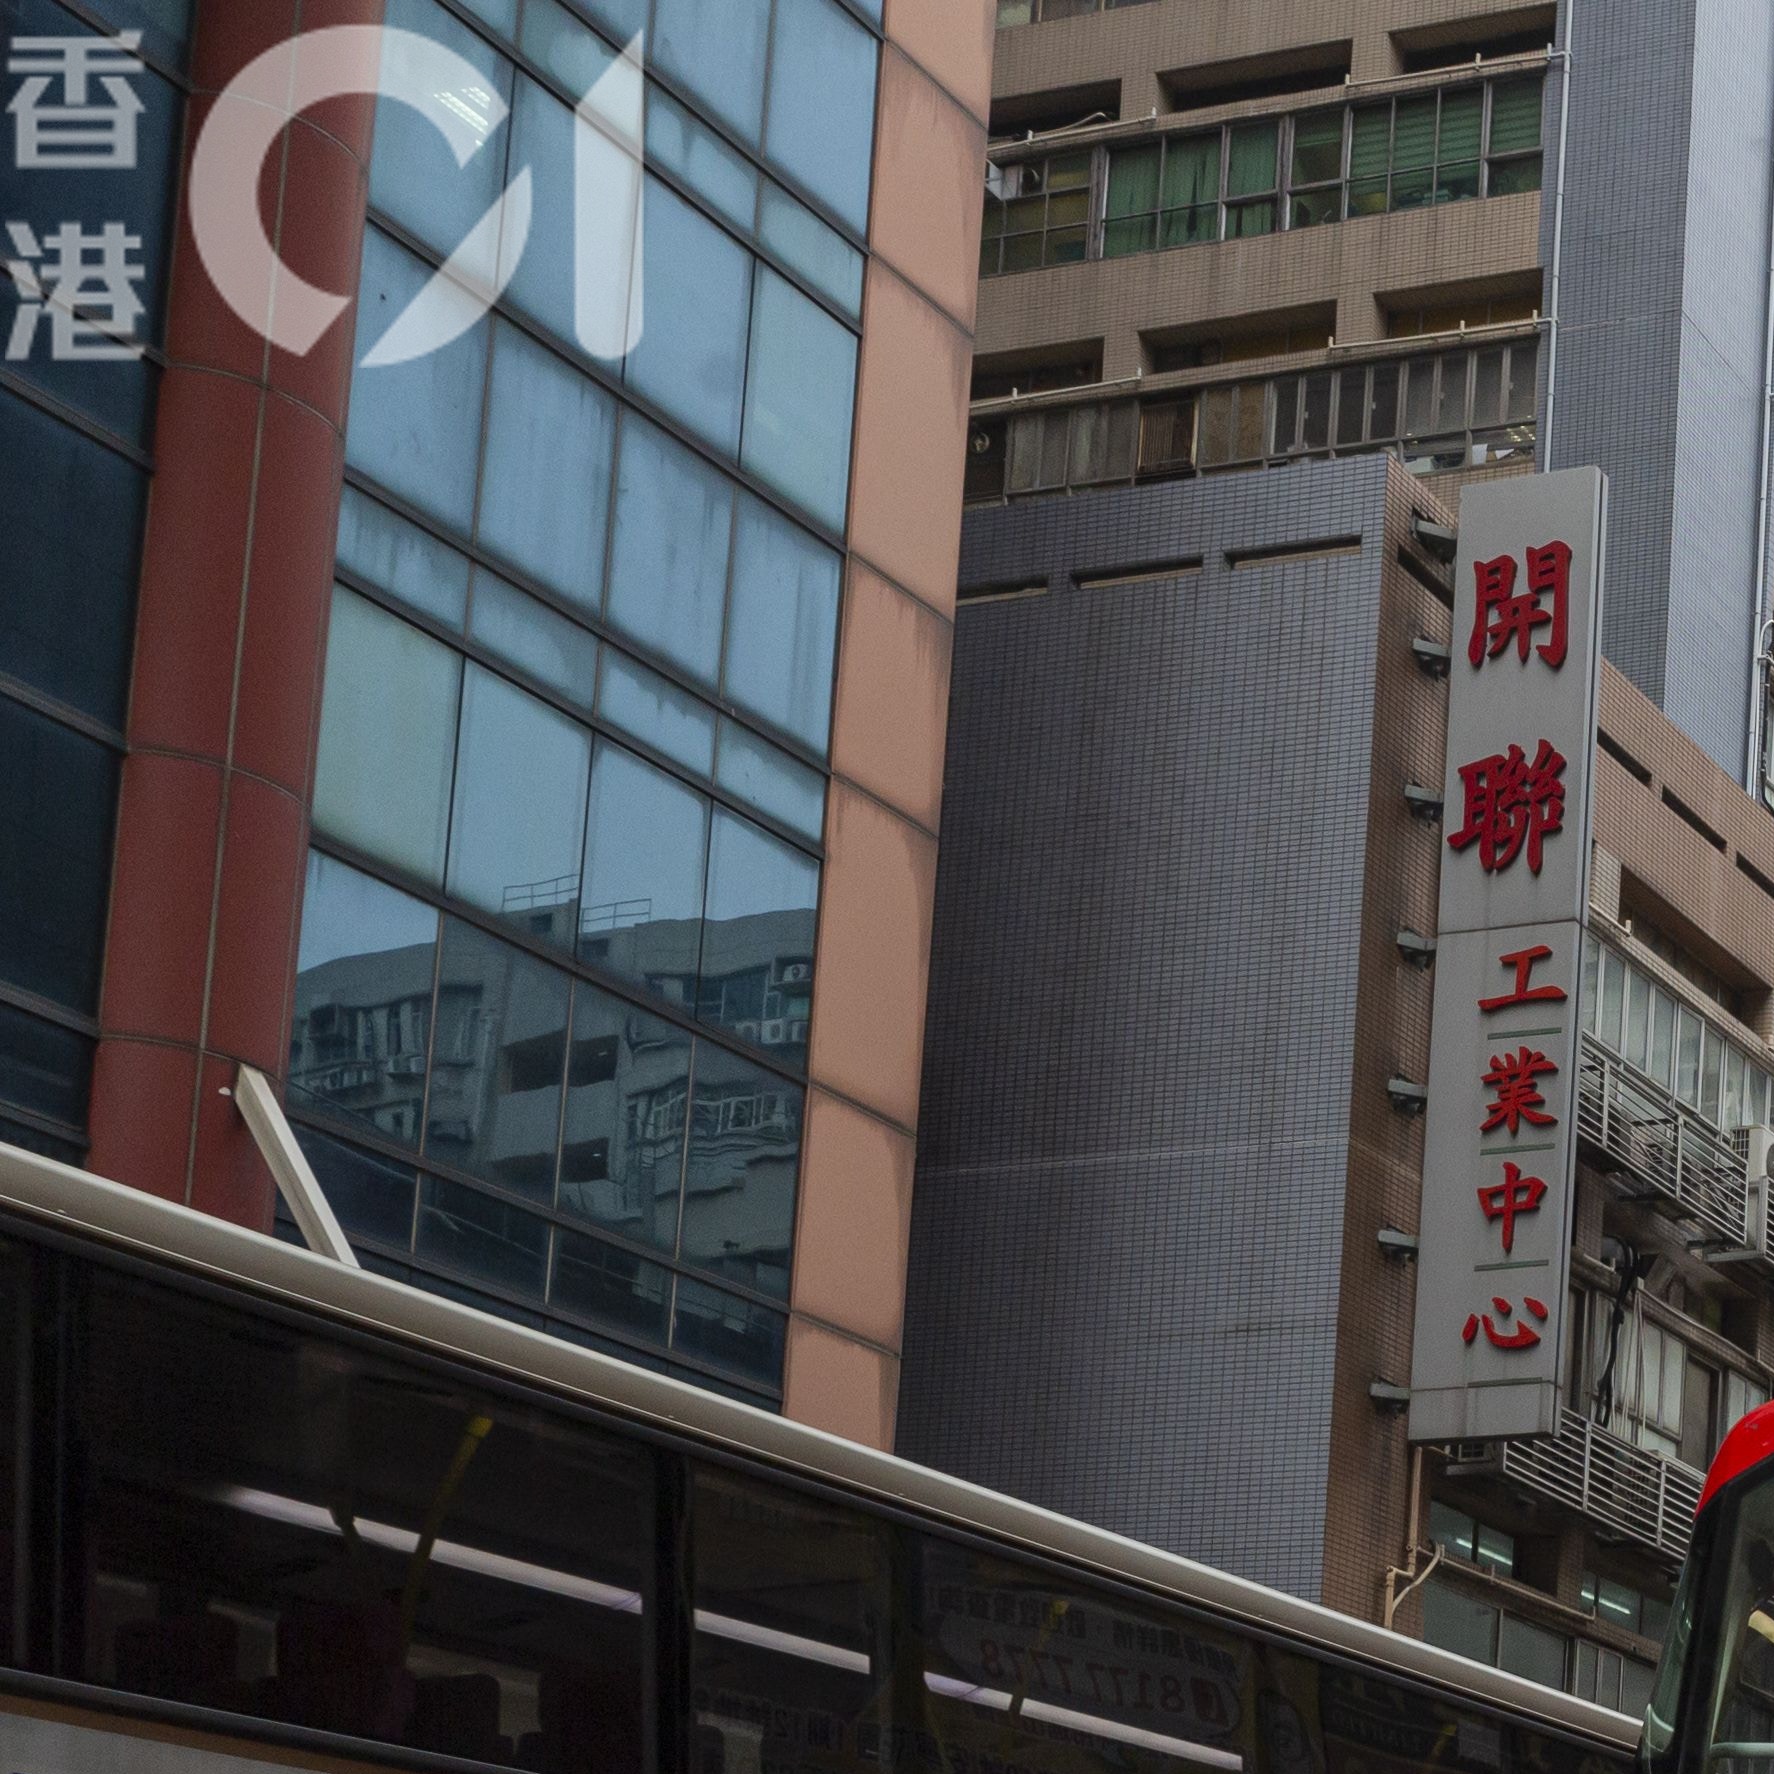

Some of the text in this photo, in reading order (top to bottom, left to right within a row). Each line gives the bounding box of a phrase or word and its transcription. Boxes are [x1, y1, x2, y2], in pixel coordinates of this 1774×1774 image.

[1446, 539, 1573, 1349] 開聯工業中心
